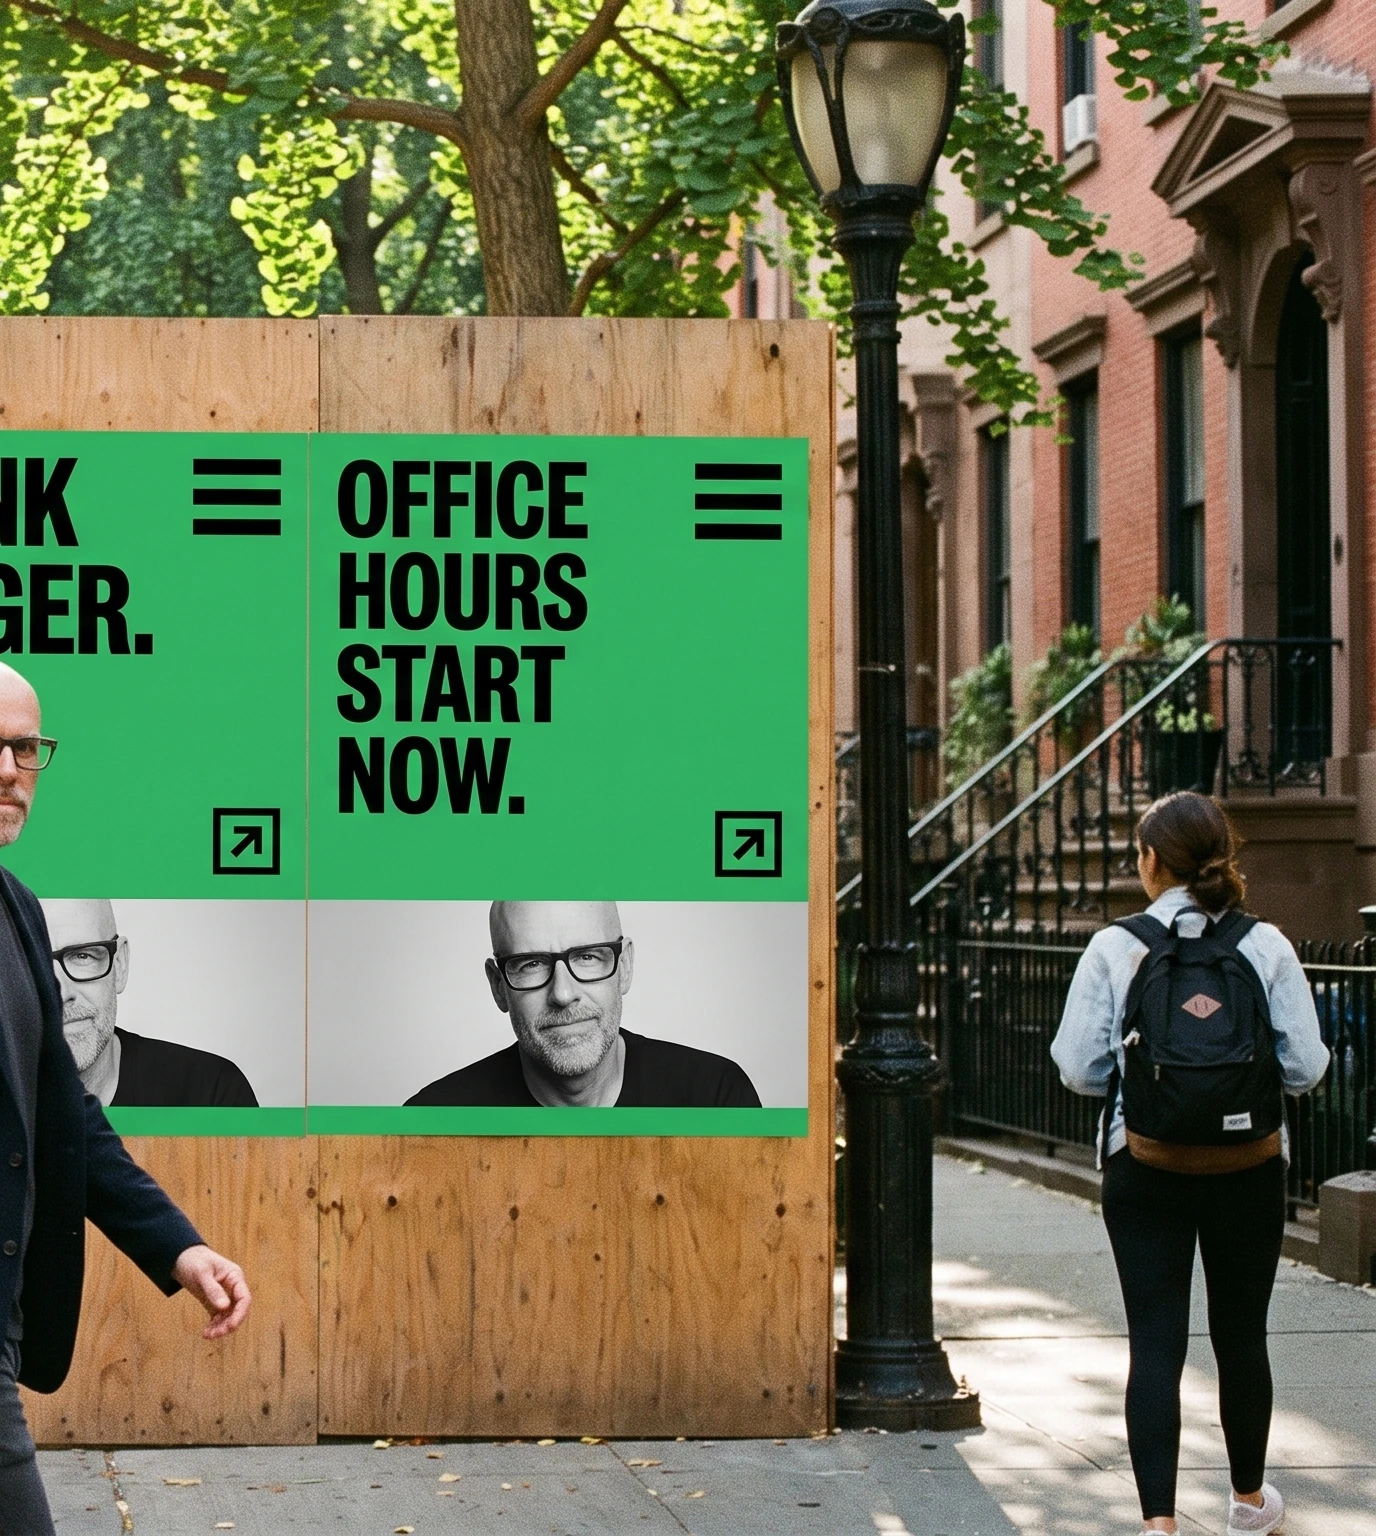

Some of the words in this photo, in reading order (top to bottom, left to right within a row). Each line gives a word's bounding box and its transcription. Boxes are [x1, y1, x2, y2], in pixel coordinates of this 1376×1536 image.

[337, 459, 589, 540] OFFICE
[339, 551, 588, 632] HOURS
[336, 643, 566, 723] START
[338, 735, 525, 815] NOW.
